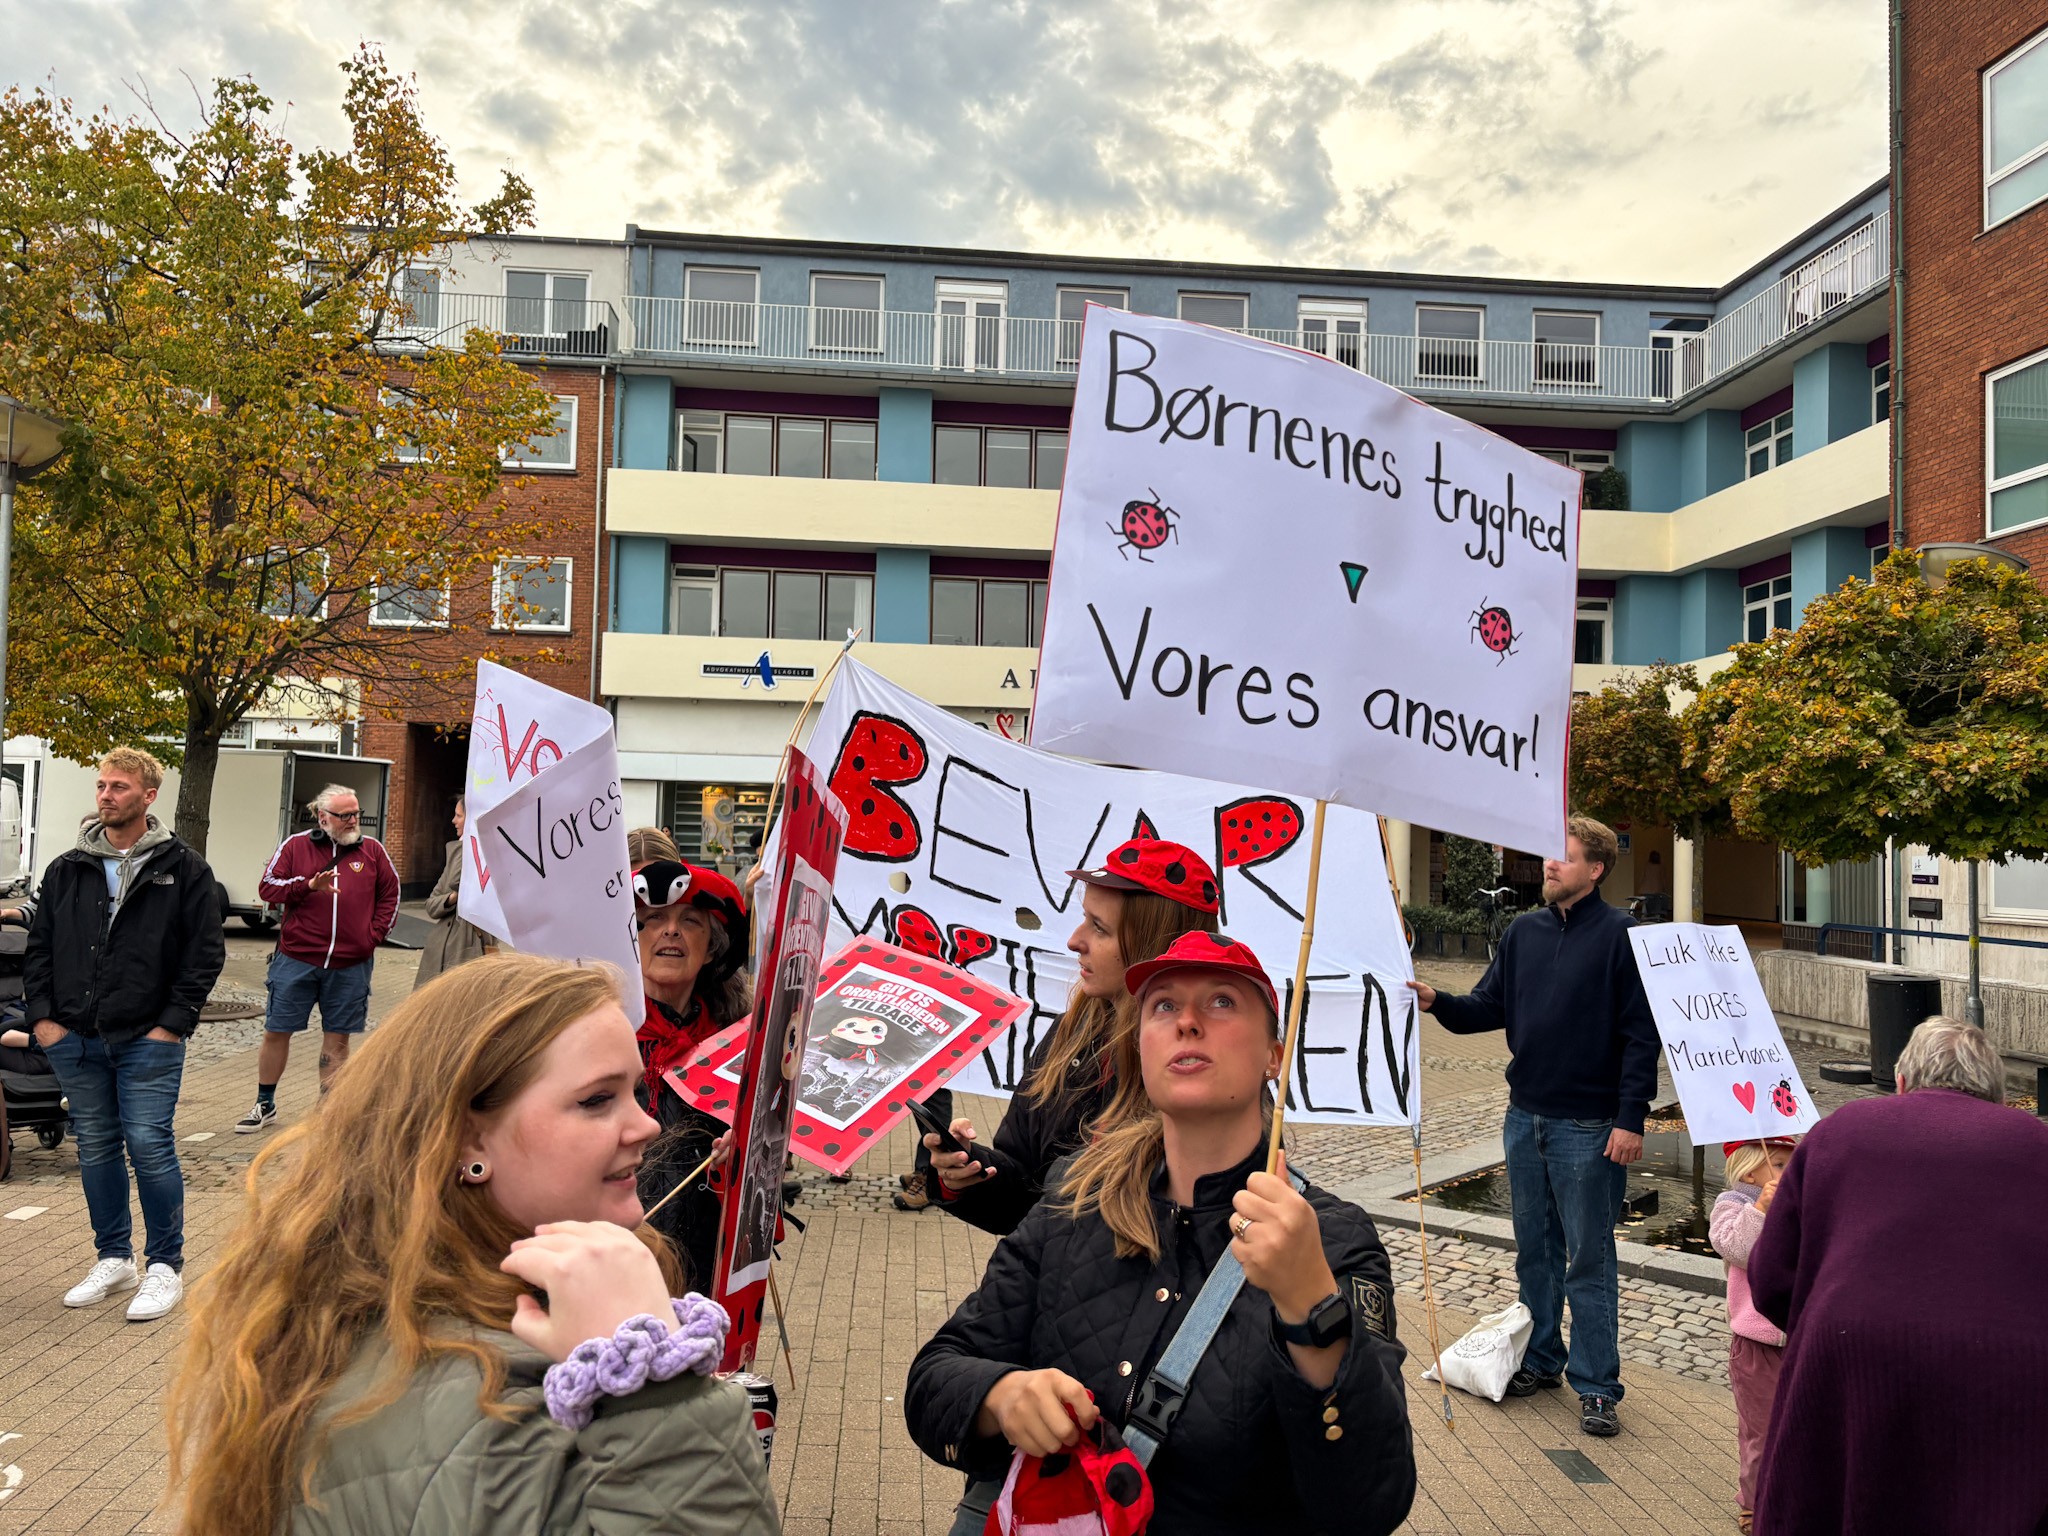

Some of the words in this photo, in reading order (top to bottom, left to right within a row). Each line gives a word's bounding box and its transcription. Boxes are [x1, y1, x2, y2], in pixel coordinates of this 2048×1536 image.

[1105, 329, 1402, 500] Børnenes
[1425, 441, 1567, 568] tryghed
[705, 666, 757, 674] ADVOKATHUSET
[1087, 602, 1320, 728] Vores
[1363, 688, 1540, 777] ansvar!
[496, 780, 623, 879] Vores
[605, 867, 625, 899] er
[1642, 933, 1697, 968] Luk
[1702, 932, 1740, 963] ikke
[839, 985, 950, 1035] ORDENTLIGHEDEN
[878, 982, 912, 997] GIV
[908, 991, 935, 1008] OS
[1671, 991, 1748, 1022] VORES
[848, 998, 924, 1034] TILBAGE
[1667, 1036, 1785, 1072] Mariehøne!
